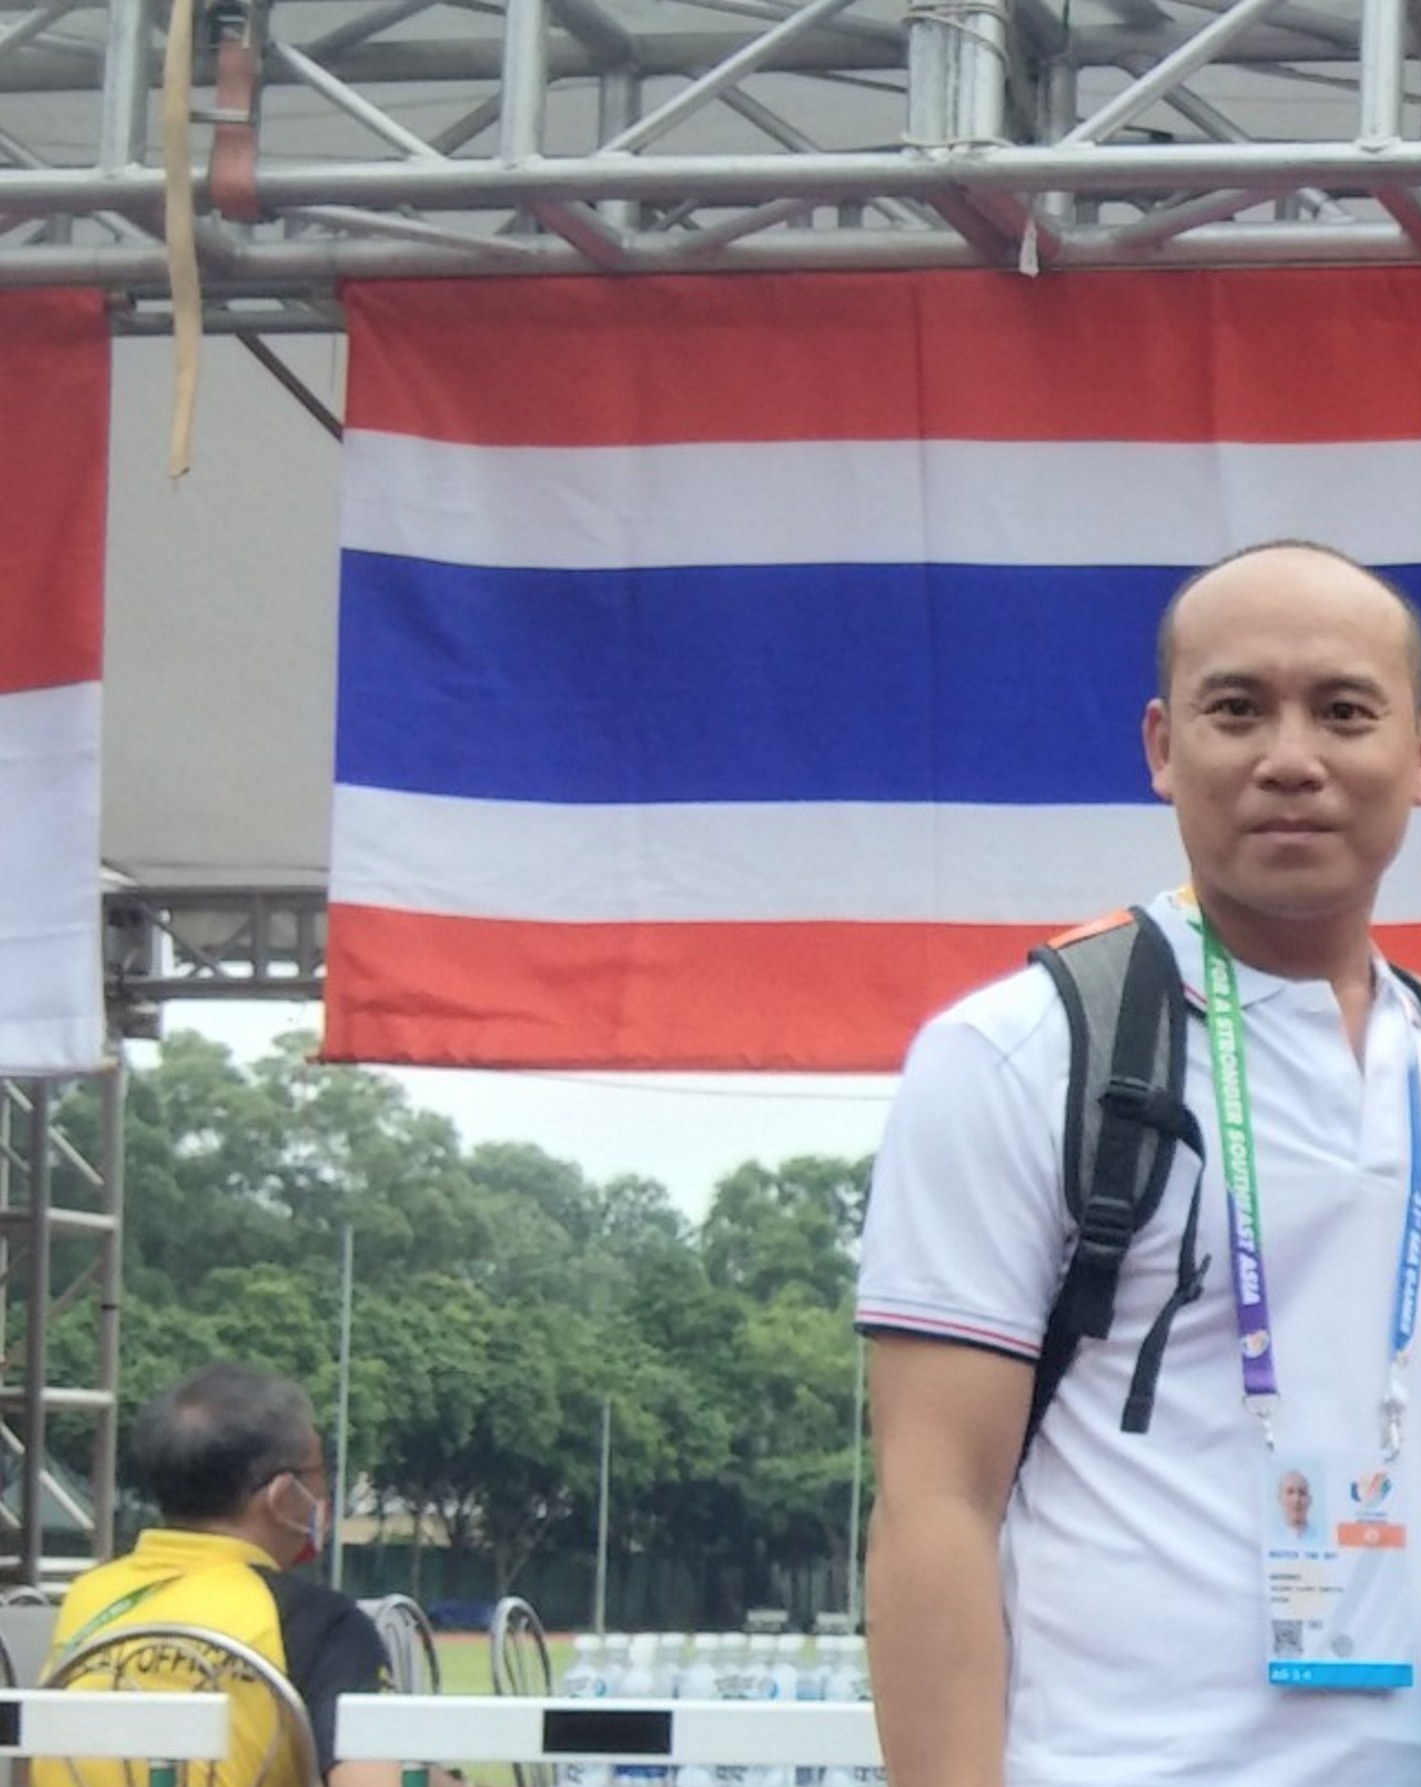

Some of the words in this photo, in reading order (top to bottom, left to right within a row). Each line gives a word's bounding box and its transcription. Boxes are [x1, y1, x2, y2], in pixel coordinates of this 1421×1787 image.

[1211, 955, 1230, 996] FOR
[1215, 997, 1232, 1012] A
[1215, 1016, 1243, 1123] STRONGER
[1238, 1252, 1261, 1306] ASIA
